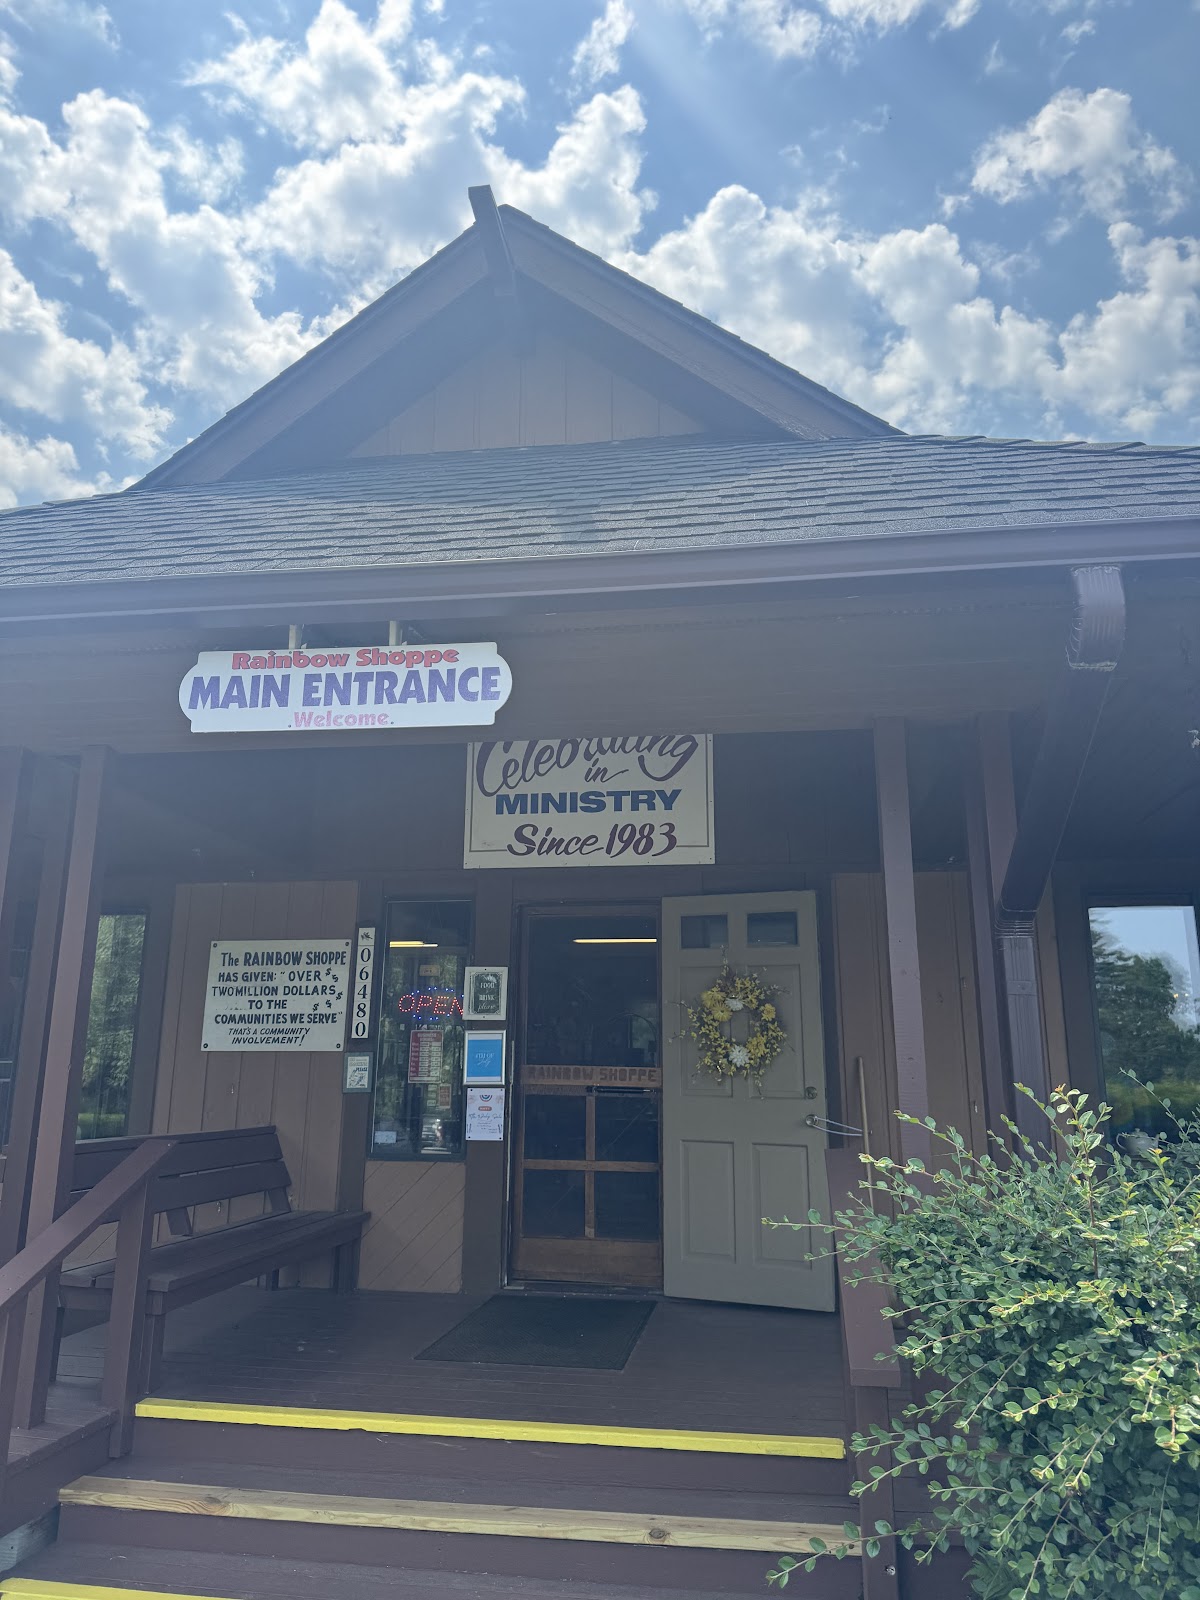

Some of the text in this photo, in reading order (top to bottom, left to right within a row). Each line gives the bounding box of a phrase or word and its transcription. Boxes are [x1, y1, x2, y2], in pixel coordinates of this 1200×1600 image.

[232, 648, 459, 670] Rainbow Shoppe
[188, 666, 500, 710] MAIN ENTRANCE
[293, 710, 390, 727] Welcome
[584, 758, 629, 783] in
[495, 789, 682, 815] MINISTRY
[507, 822, 677, 858] Since 1983
[221, 950, 347, 966] The RAINBOW SHOPPE
[218, 971, 238, 982] HAS
[241, 971, 277, 982] GIVEN:
[283, 985, 336, 996] DOLLARS
[355, 947, 371, 1037] 06480
[248, 1000, 263, 1010] TO
[266, 1000, 288, 1009] THE
[398, 994, 464, 1015] OPEN
[214, 1014, 287, 1024] COMMUNITIES
[290, 1013, 305, 1024] WE
[259, 1027, 310, 1036] COMMUNITY
[231, 1034, 305, 1046] INVOLVEMENT!
[526, 1066, 657, 1082] RAINBOW SHOPPE
